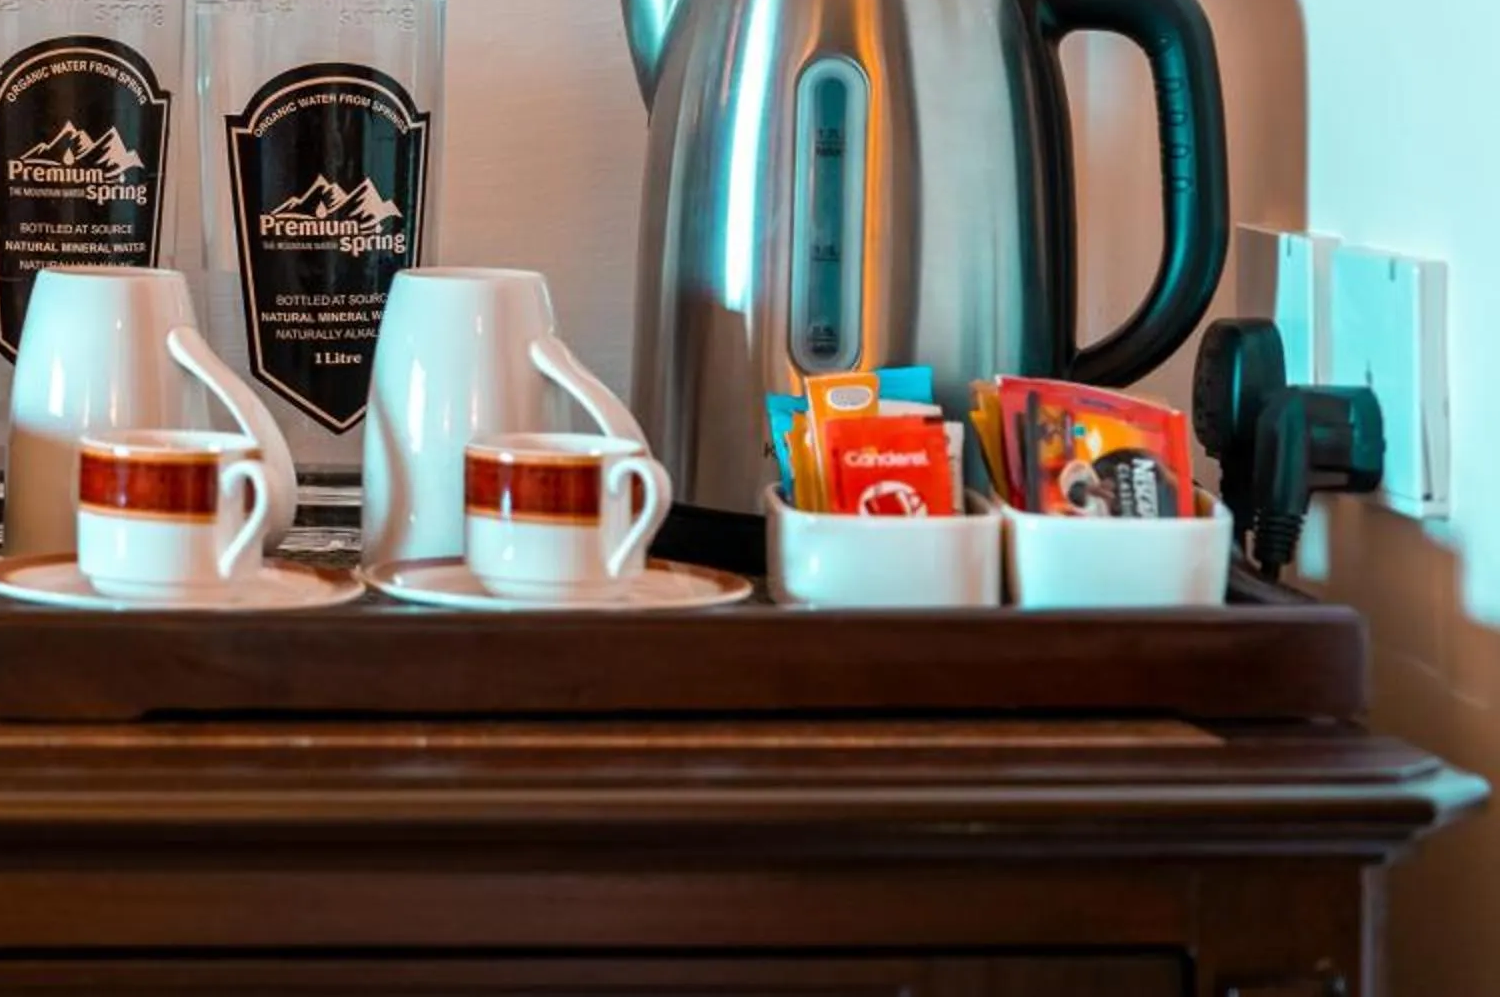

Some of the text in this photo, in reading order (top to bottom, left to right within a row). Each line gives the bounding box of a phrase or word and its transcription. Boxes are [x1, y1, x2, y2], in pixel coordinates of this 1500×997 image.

[6, 66, 49, 103] ORGANIC
[50, 60, 88, 74] WATER
[89, 61, 118, 79] FROM
[254, 102, 297, 137] ORGANIC
[299, 93, 337, 107] WATER
[339, 94, 371, 107] FROM
[7, 159, 103, 183] Premium
[20, 223, 134, 235] BOTTLED AT SOURCE
[260, 214, 359, 236] Premium
[5, 241, 146, 254] NATURAL MINERAL WATER
[276, 293, 388, 306] BOTTLED AT SOURC
[261, 311, 315, 322] NATURAL
[317, 312, 369, 322] MINERAL
[275, 328, 380, 340] NATURALLY ALKAL
[314, 352, 363, 364] 1 Litre
